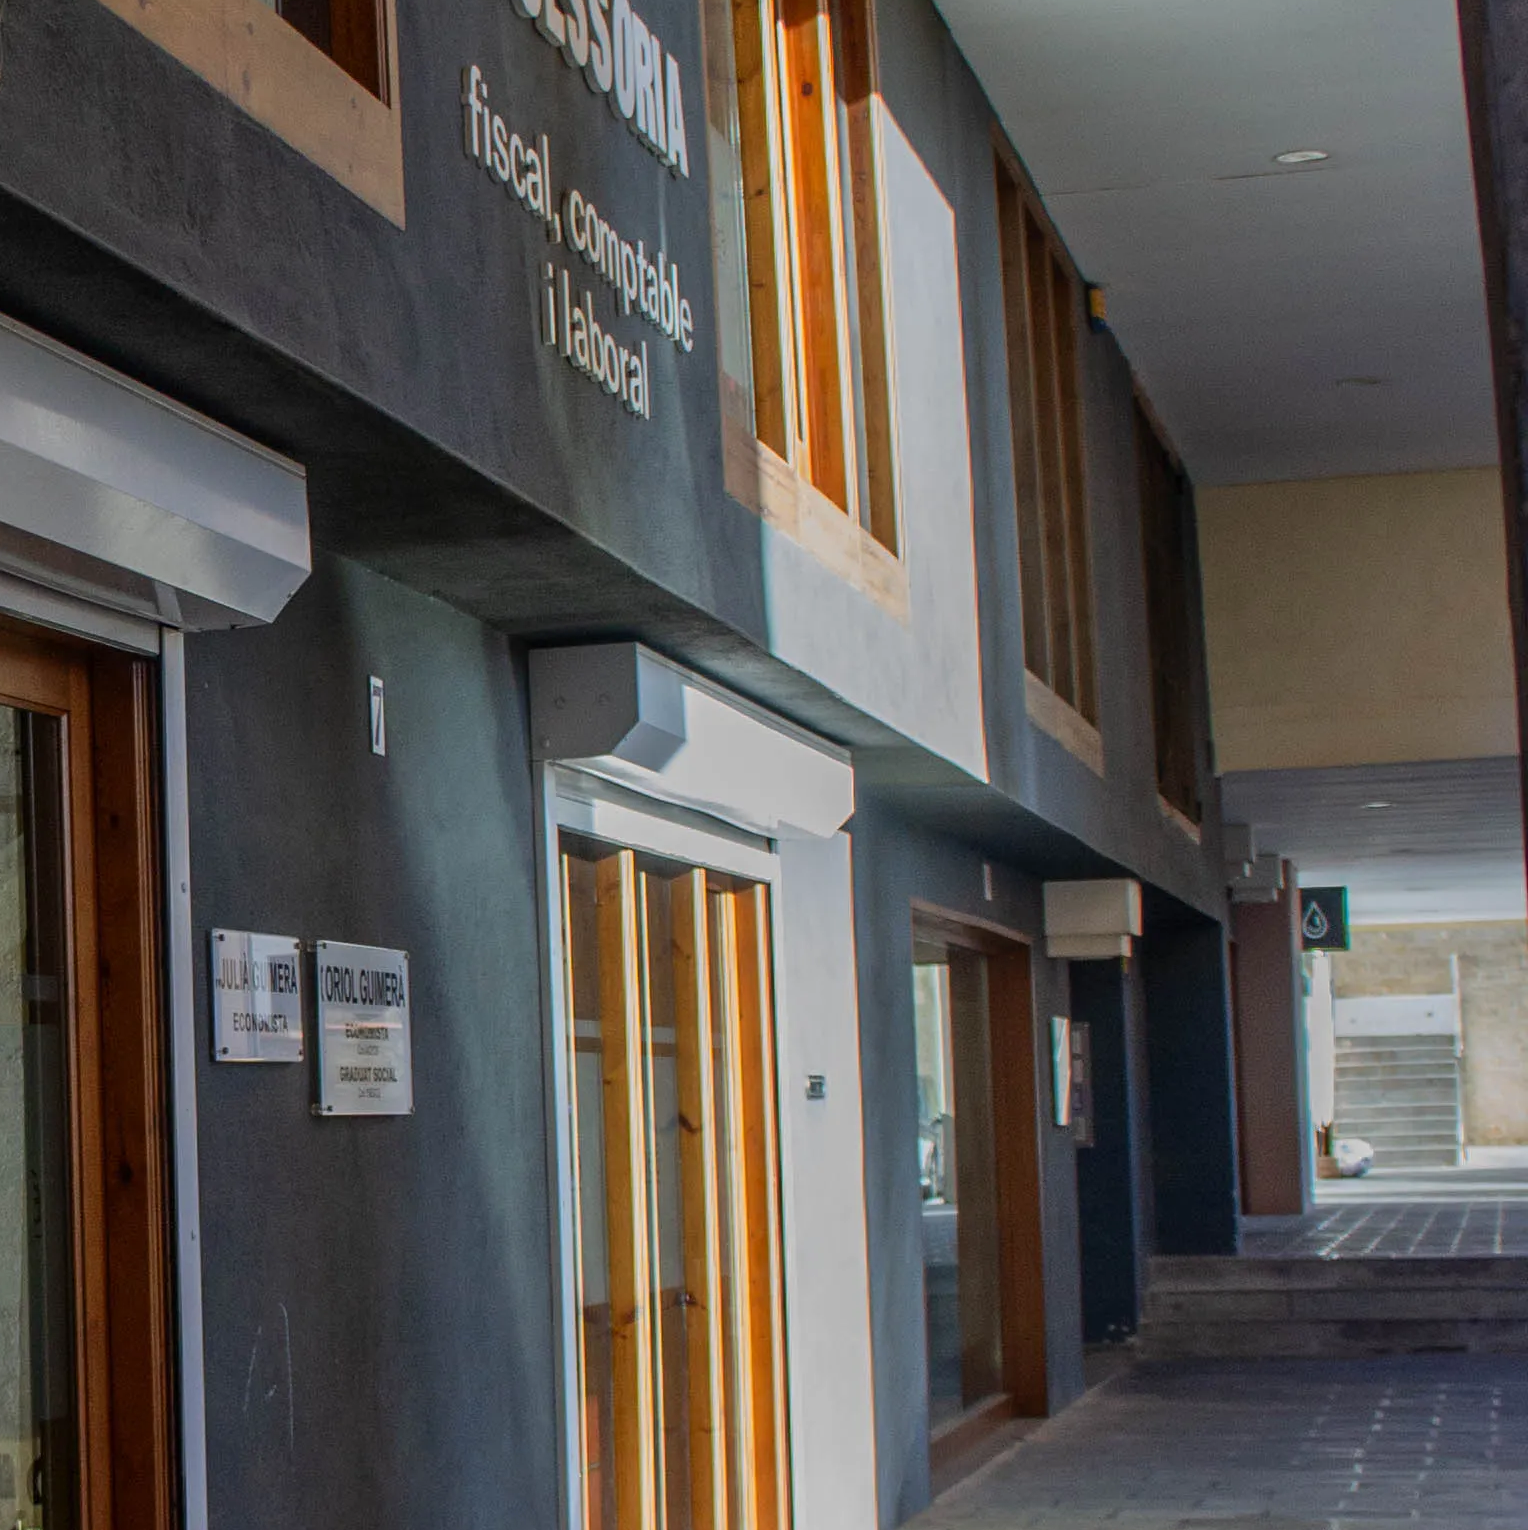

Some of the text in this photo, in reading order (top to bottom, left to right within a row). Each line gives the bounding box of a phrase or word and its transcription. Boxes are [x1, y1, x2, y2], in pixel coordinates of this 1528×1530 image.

[461, 64, 694, 353] fiscal, comptable
[541, 261, 651, 421] i laboral
[221, 952, 249, 991] JULIÀ
[325, 966, 358, 1005] ORIOL
[359, 965, 406, 1008] GUIMERÀ
[232, 1011, 289, 1035] ECONOMISTA
